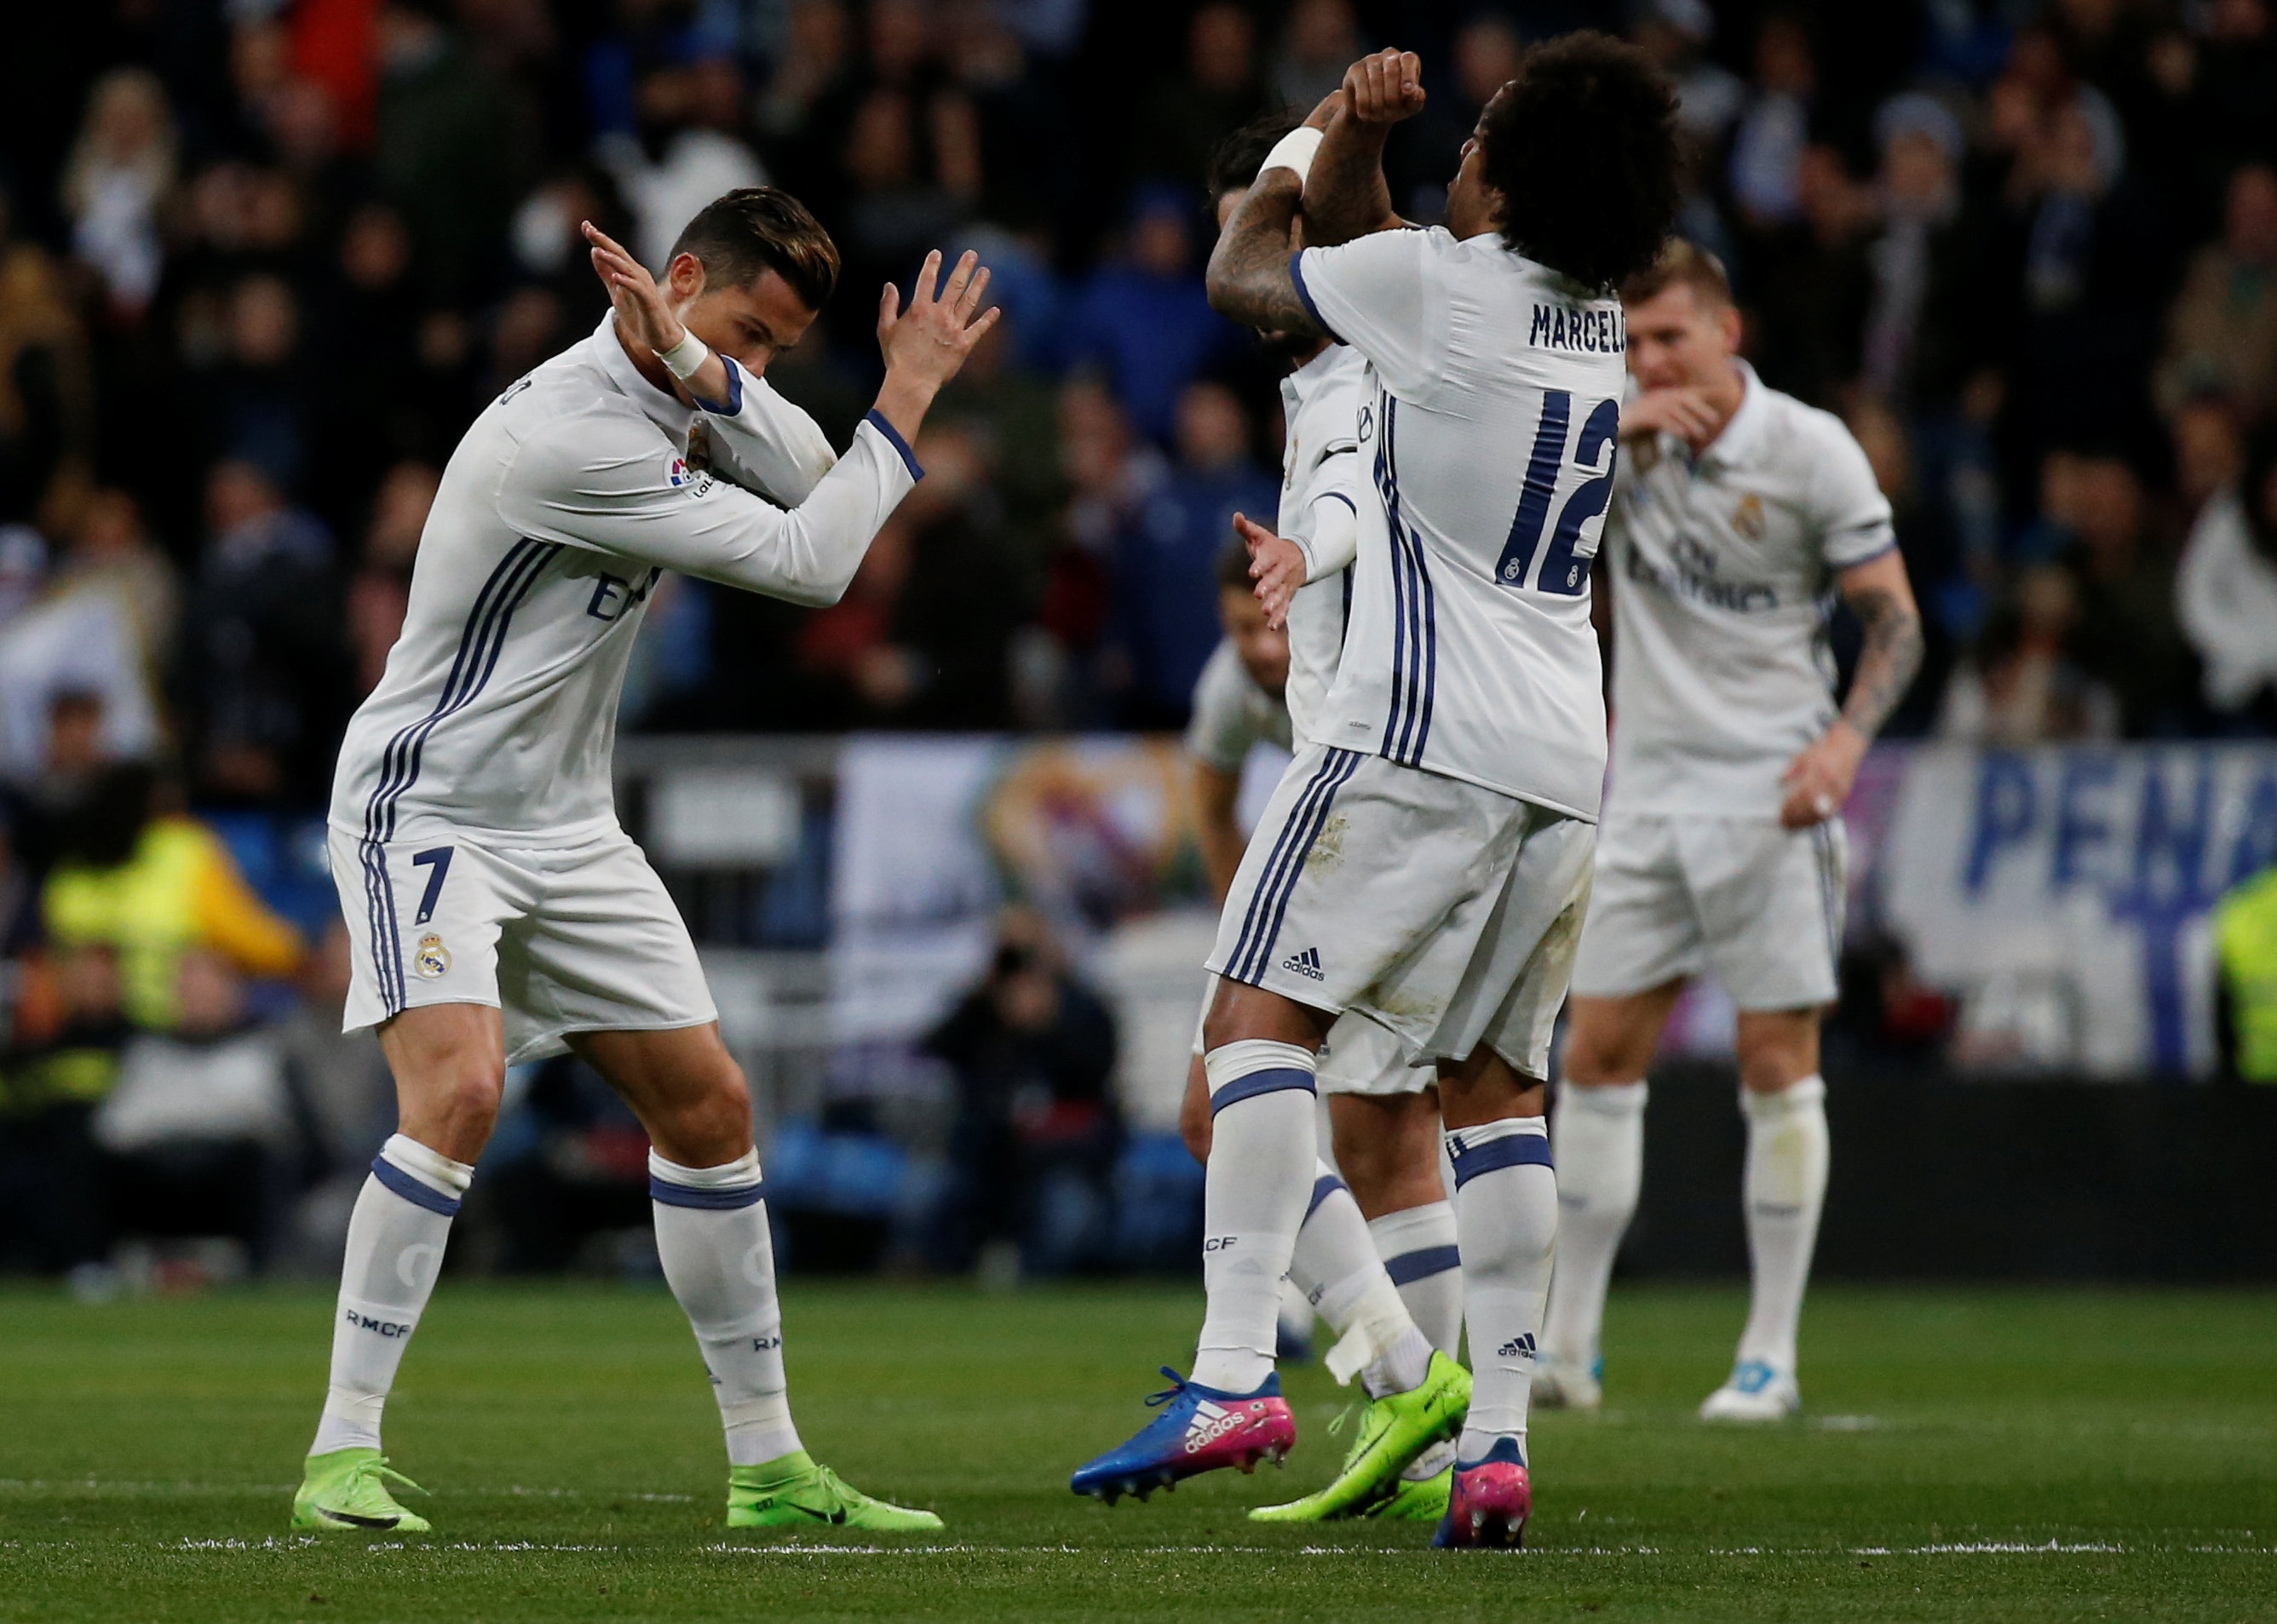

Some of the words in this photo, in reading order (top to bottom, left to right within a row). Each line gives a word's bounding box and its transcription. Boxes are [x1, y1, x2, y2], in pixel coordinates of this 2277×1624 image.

[1529, 303, 1624, 353] MARCEL
[1494, 391, 1619, 596] 12
[412, 845, 455, 927] 7
[1282, 960, 1325, 982] adidas
[347, 1309, 411, 1339] RMCF
[1185, 1411, 1245, 1455] adidas
